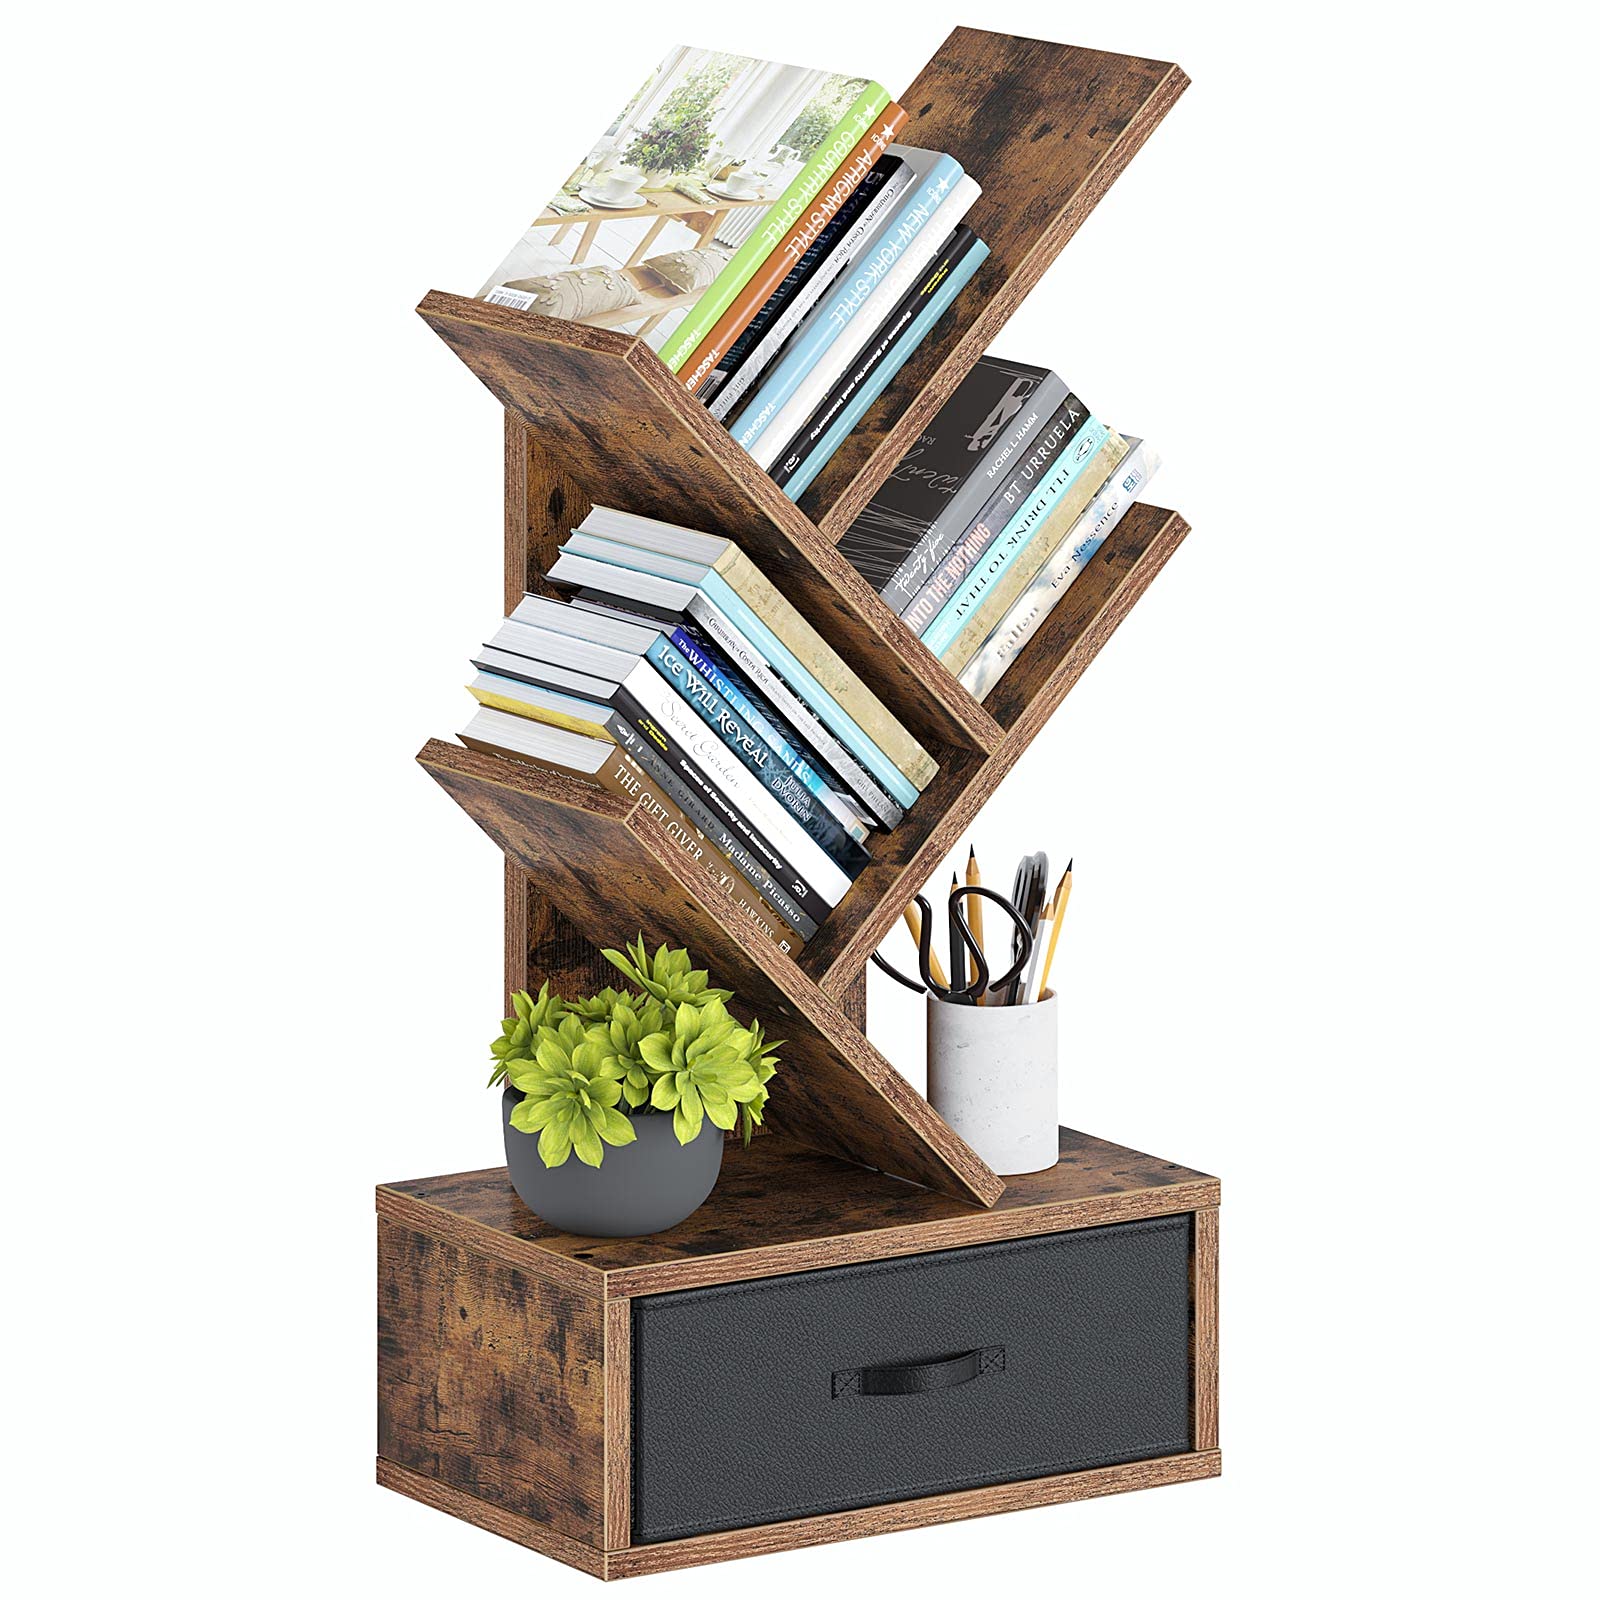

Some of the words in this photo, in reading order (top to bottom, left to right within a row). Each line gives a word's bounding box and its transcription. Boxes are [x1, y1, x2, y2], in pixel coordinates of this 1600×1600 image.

[798, 129, 857, 203] COUNTRY
[820, 148, 874, 216] AFRICAN
[761, 197, 802, 247] STYLE
[784, 212, 827, 262] STYLE
[897, 203, 930, 244] NEW
[865, 240, 902, 282] YORK
[828, 278, 872, 330] STYLE
[884, 310, 913, 343] Spaces
[853, 351, 881, 385] Security
[877, 342, 888, 354] of
[841, 382, 857, 400] and
[739, 402, 776, 448] TASCHEN
[809, 397, 844, 441] Insecurity
[985, 446, 1014, 479] RACHEL
[1016, 412, 1039, 439] HAMM
[1002, 480, 1025, 504] BT
[1019, 406, 1082, 481] URRUELA
[1045, 467, 1072, 498] I'LL
[1006, 498, 1048, 548] DRINK
[1049, 564, 1072, 589] Eva
[1070, 500, 1121, 563] Nessence
[905, 596, 935, 633] INTO
[925, 572, 952, 603] THE
[943, 522, 992, 580] NOTHING
[987, 550, 1009, 574] TO
[952, 574, 990, 620] THAT
[677, 638, 691, 654] The
[661, 699, 698, 741] Secret
[694, 737, 741, 788] Garden
[613, 764, 642, 797] THE
[638, 791, 669, 823] GIFT
[666, 820, 704, 861] GIVER
[679, 759, 705, 787] Spaces
[702, 783, 713, 794] of
[709, 791, 739, 823] Security
[736, 820, 752, 837] and
[748, 834, 783, 870] Insecurity
[718, 833, 764, 882] Madame
[762, 879, 802, 923] Picasso
[738, 898, 775, 938] HAWKINS
